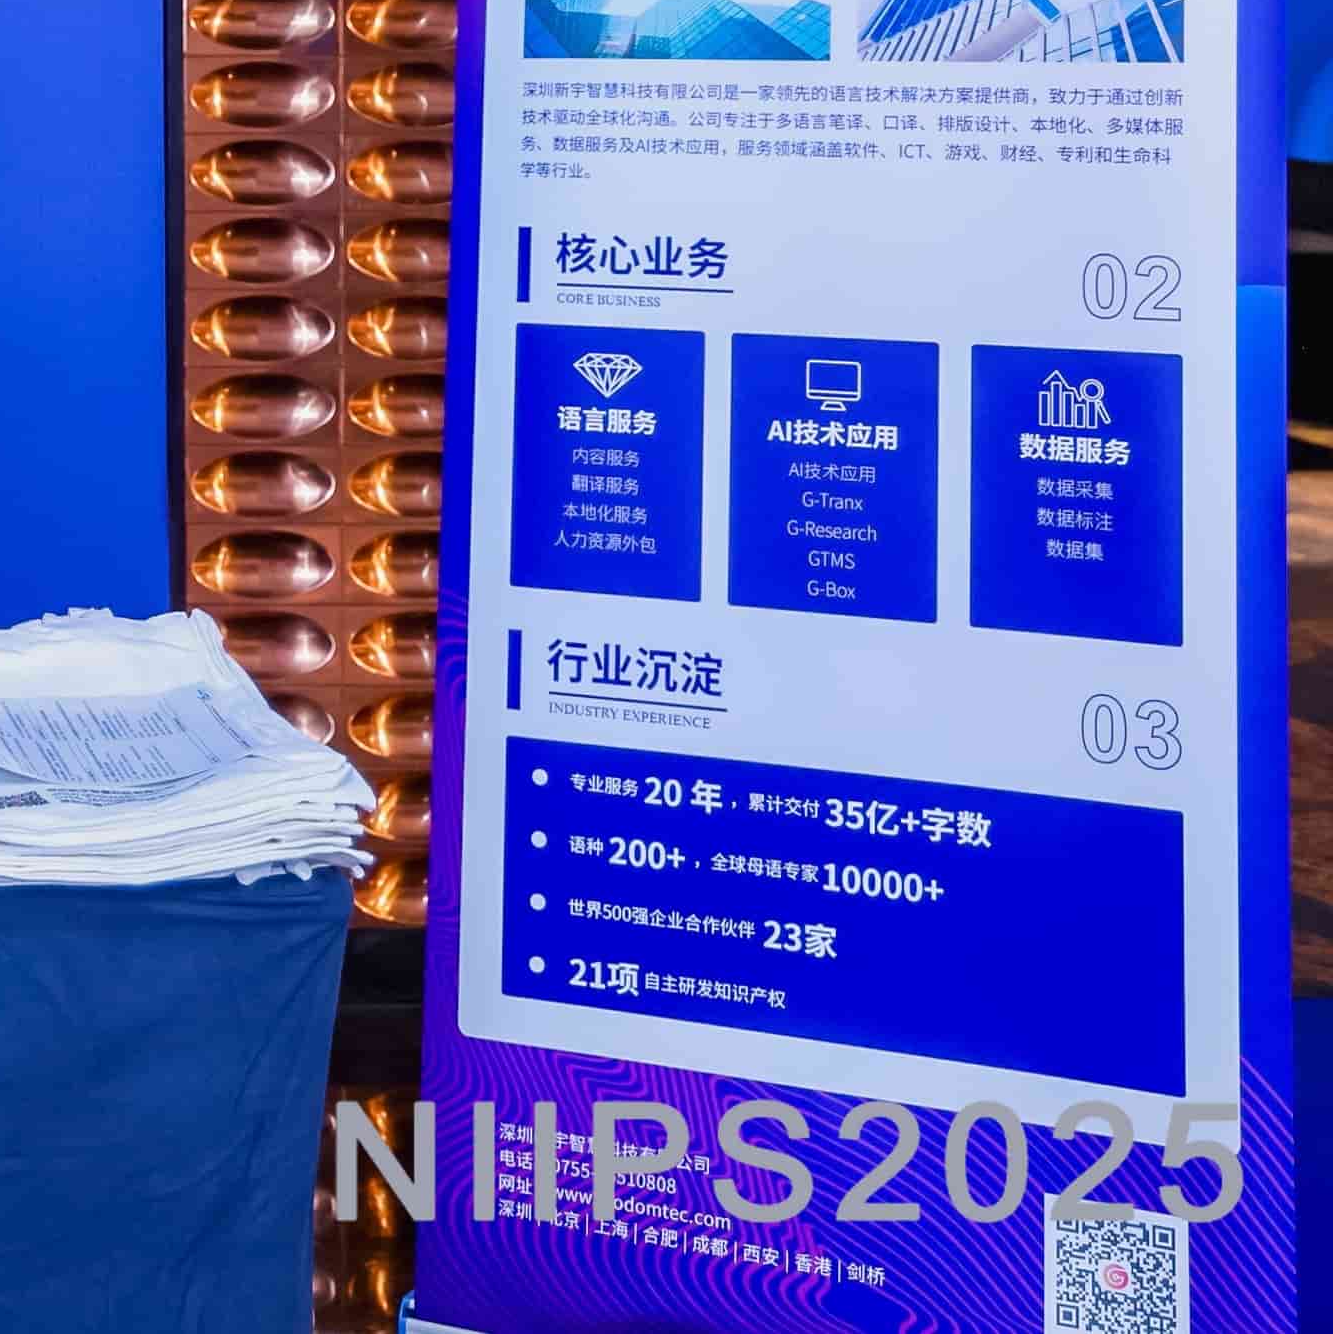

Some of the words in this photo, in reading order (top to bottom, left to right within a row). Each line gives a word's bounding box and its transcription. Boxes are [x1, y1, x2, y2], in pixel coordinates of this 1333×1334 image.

[519, 162, 593, 180] 学等行业。
[555, 231, 729, 280] 核心业务
[556, 292, 594, 306] CORE
[597, 293, 661, 308] BUSINESS
[1082, 252, 1183, 323] 02
[556, 404, 658, 437] 语言服务
[766, 418, 899, 452] AI技术应用
[571, 446, 641, 469] 内容服务
[1018, 432, 1131, 467] 数据服务
[571, 473, 640, 497] 翻译服务
[788, 460, 877, 486] AI技术应用
[801, 490, 864, 512] G-Tranx
[1036, 476, 1114, 502] 数据采集
[563, 501, 649, 526] 本地化服务
[1036, 507, 1115, 533] 数据标注
[554, 529, 657, 555] 人力资源外包
[786, 519, 878, 543] G-Research
[807, 549, 856, 570] GTMS
[1045, 538, 1105, 563] 数据集
[807, 578, 856, 601] G-Box
[547, 637, 723, 698] 行业沉淀
[548, 701, 618, 721] INDUSTRY
[622, 708, 712, 729] EXPERIENCE
[1080, 693, 1184, 771] 03
[569, 772, 639, 798] 专业服务
[824, 796, 993, 849] 35亿+字数
[568, 834, 604, 857] 语种
[822, 863, 945, 903] 10000+
[568, 898, 756, 940] 世界500强企业合作伙伴
[762, 920, 838, 960] 23家
[568, 958, 641, 997] 21项
[644, 972, 787, 1009] 自主研发知识产权
